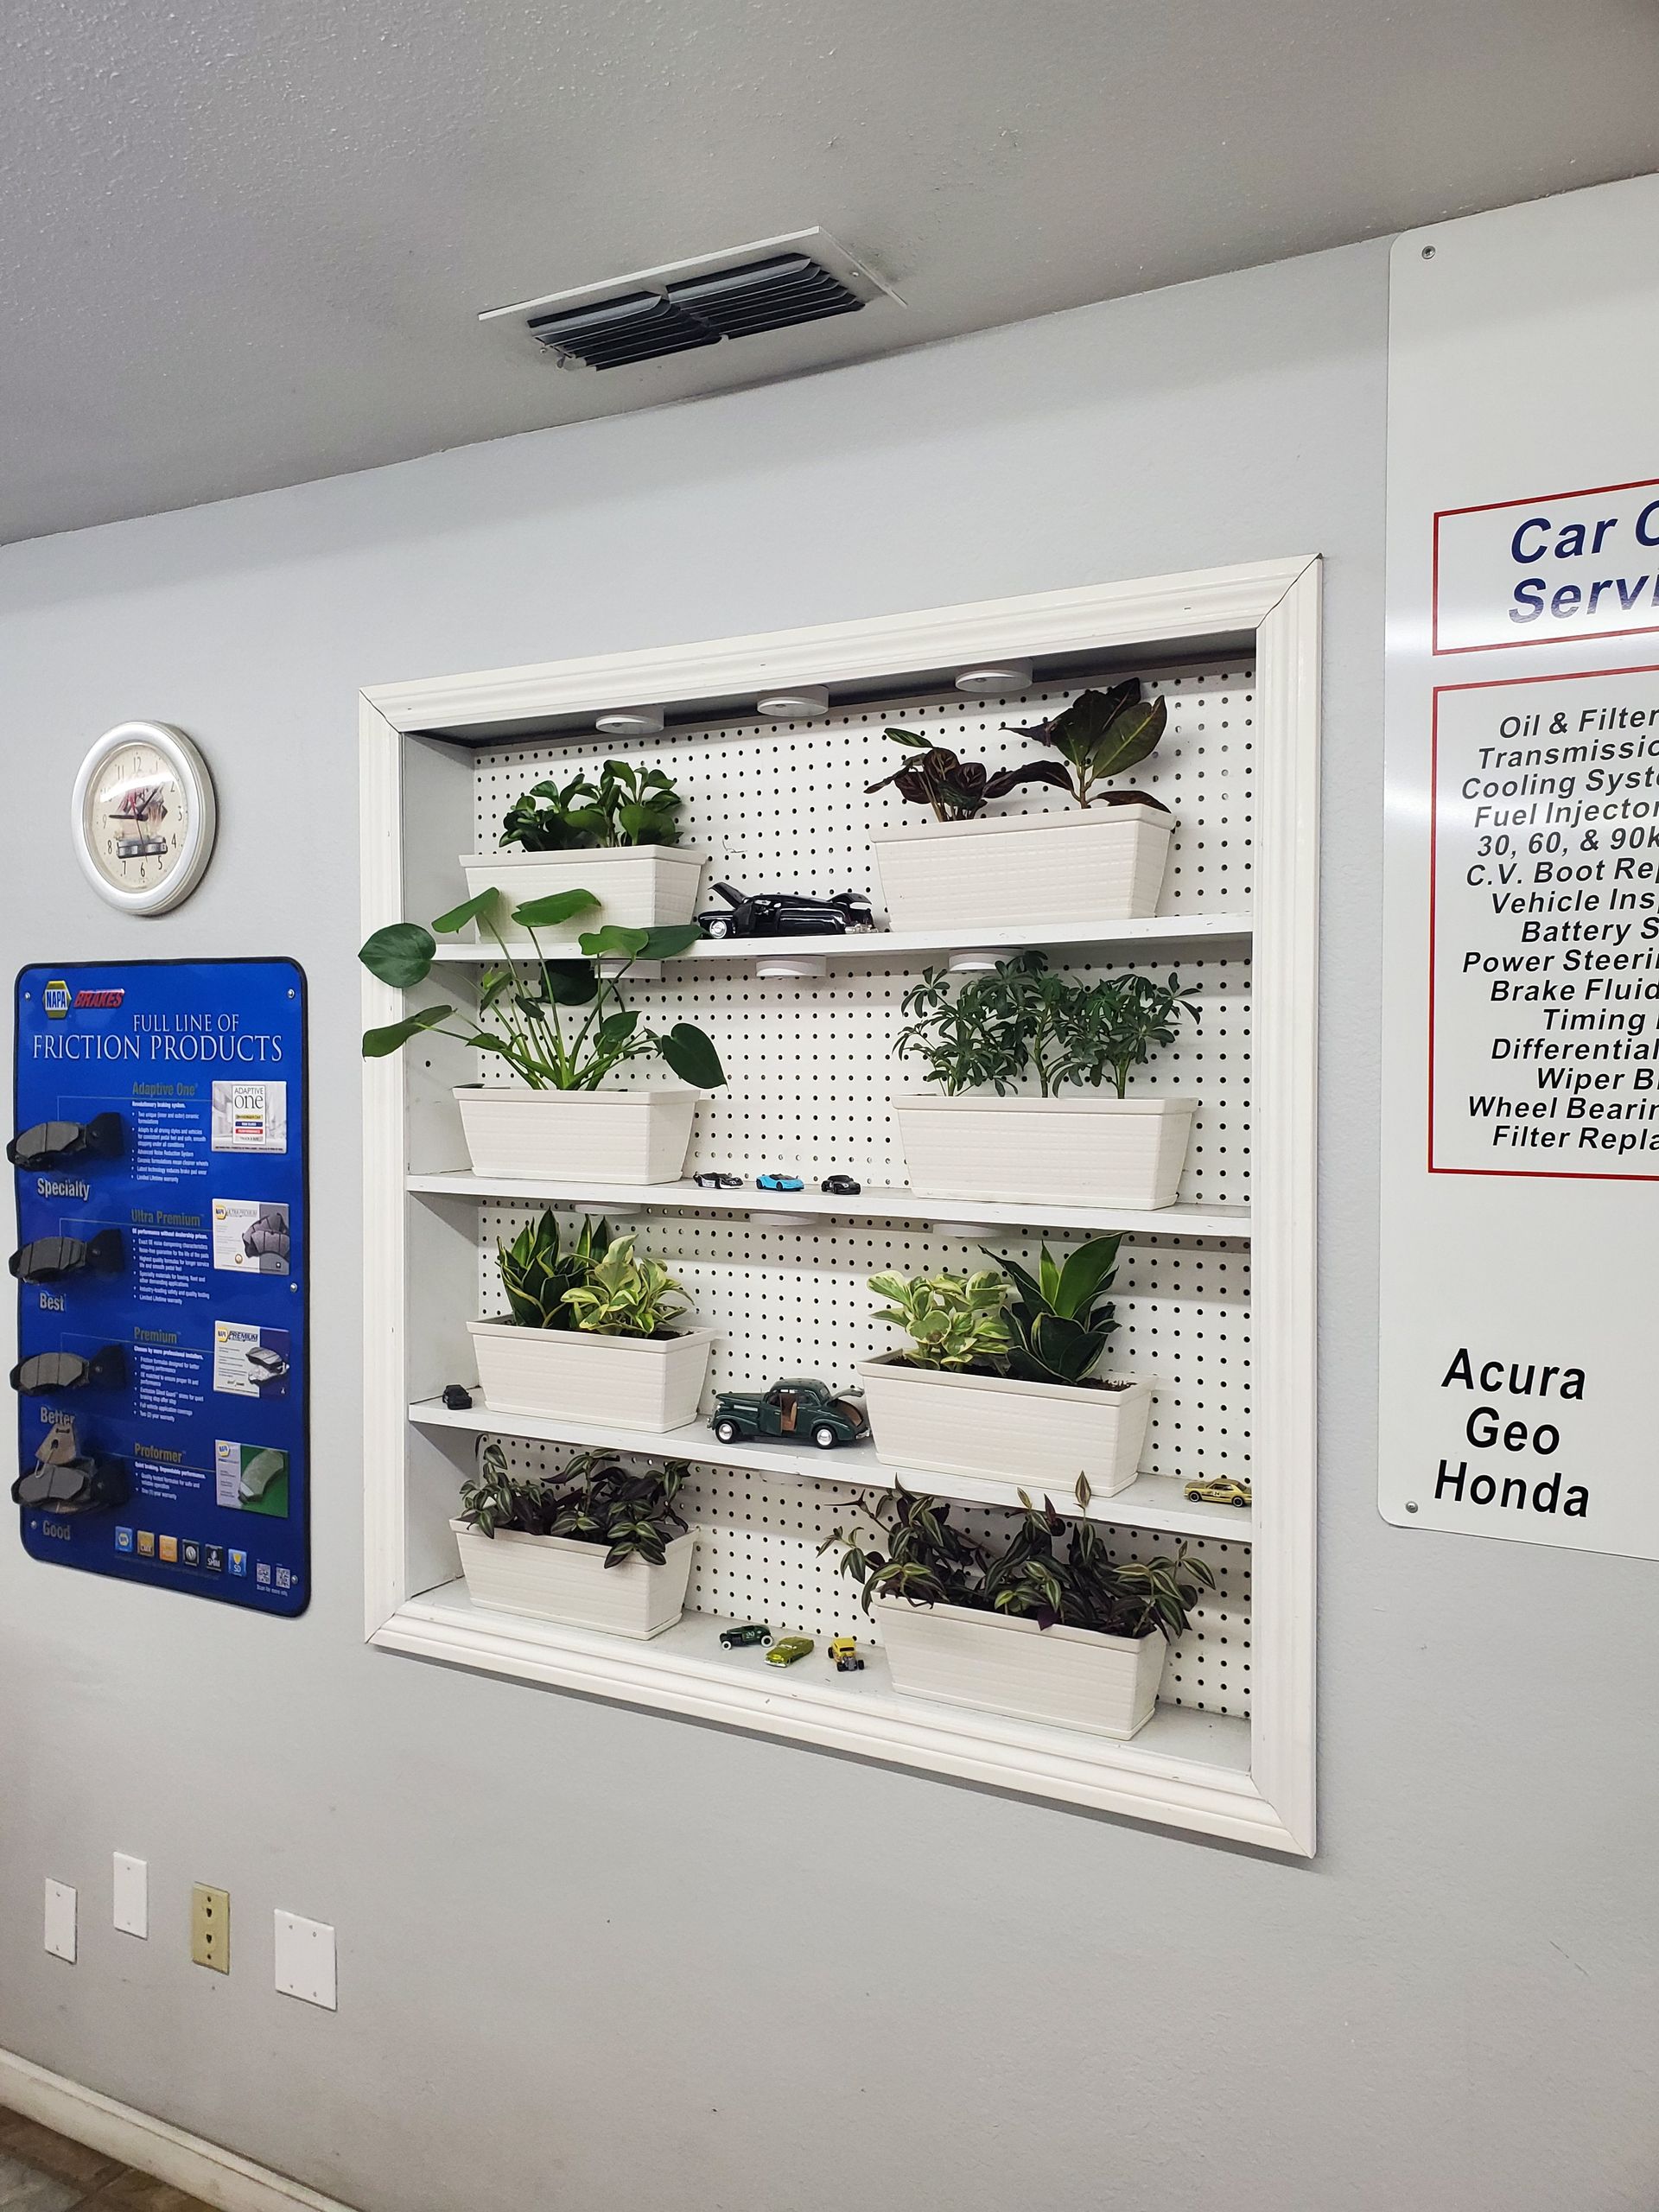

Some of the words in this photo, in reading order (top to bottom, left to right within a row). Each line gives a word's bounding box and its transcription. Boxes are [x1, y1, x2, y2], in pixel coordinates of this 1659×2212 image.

[1511, 518, 1618, 564] Car
[1509, 567, 1659, 624] Servi
[1499, 715, 1540, 739] Oil
[1548, 712, 1568, 734] &
[1579, 707, 1659, 732] Filter
[133, 756, 142, 774] 12
[1462, 773, 1576, 799] Cooling
[1586, 766, 1659, 797] Syst
[102, 814, 107, 830] 9
[1474, 803, 1537, 828] Fuel
[107, 839, 113, 855] 8
[171, 833, 177, 849] 4
[1477, 834, 1516, 860] 30,
[1529, 831, 1568, 857] 60,
[1580, 829, 1599, 852] &
[122, 861, 127, 875] 7
[140, 861, 146, 878] 6
[158, 855, 162, 870] 5
[1466, 862, 1522, 887] C.V.
[1534, 860, 1605, 883] Boot
[1613, 857, 1659, 885] Re
[1492, 889, 1600, 914] Vehicle
[1609, 887, 1659, 914] Ins
[1521, 920, 1632, 946] Battery
[1640, 916, 1659, 940] S
[1462, 951, 1555, 973] Power
[1562, 947, 1659, 971] Steeri
[46, 990, 67, 1009] NAPA
[73, 988, 124, 1008] BRAKES
[1491, 979, 1575, 1001] Brake
[133, 1014, 170, 1032] FULL
[175, 1014, 212, 1033] LINE
[218, 1014, 239, 1033] OF
[1543, 1007, 1646, 1036] Timing
[33, 1034, 141, 1060] FRICTION
[150, 1035, 283, 1062] PRODUCTS
[1491, 1038, 1659, 1060] Differential
[132, 1081, 175, 1097] Adaptive
[1537, 1067, 1625, 1095] Wiper
[234, 1095, 264, 1109] one
[1469, 1096, 1558, 1118] Wheel
[1492, 1125, 1571, 1148] Filter
[37, 1177, 90, 1201] Specialty
[131, 1208, 154, 1224] Ultra
[156, 1211, 200, 1227] Premium
[40, 1292, 65, 1312] Best
[134, 1326, 177, 1344] Premium
[1440, 1348, 1586, 1401] Acura
[40, 1406, 75, 1425] Better
[1466, 1406, 1560, 1455] Geo
[134, 1442, 182, 1463] Proformer
[1434, 1459, 1590, 1518] Honda
[42, 1520, 71, 1541] Good
